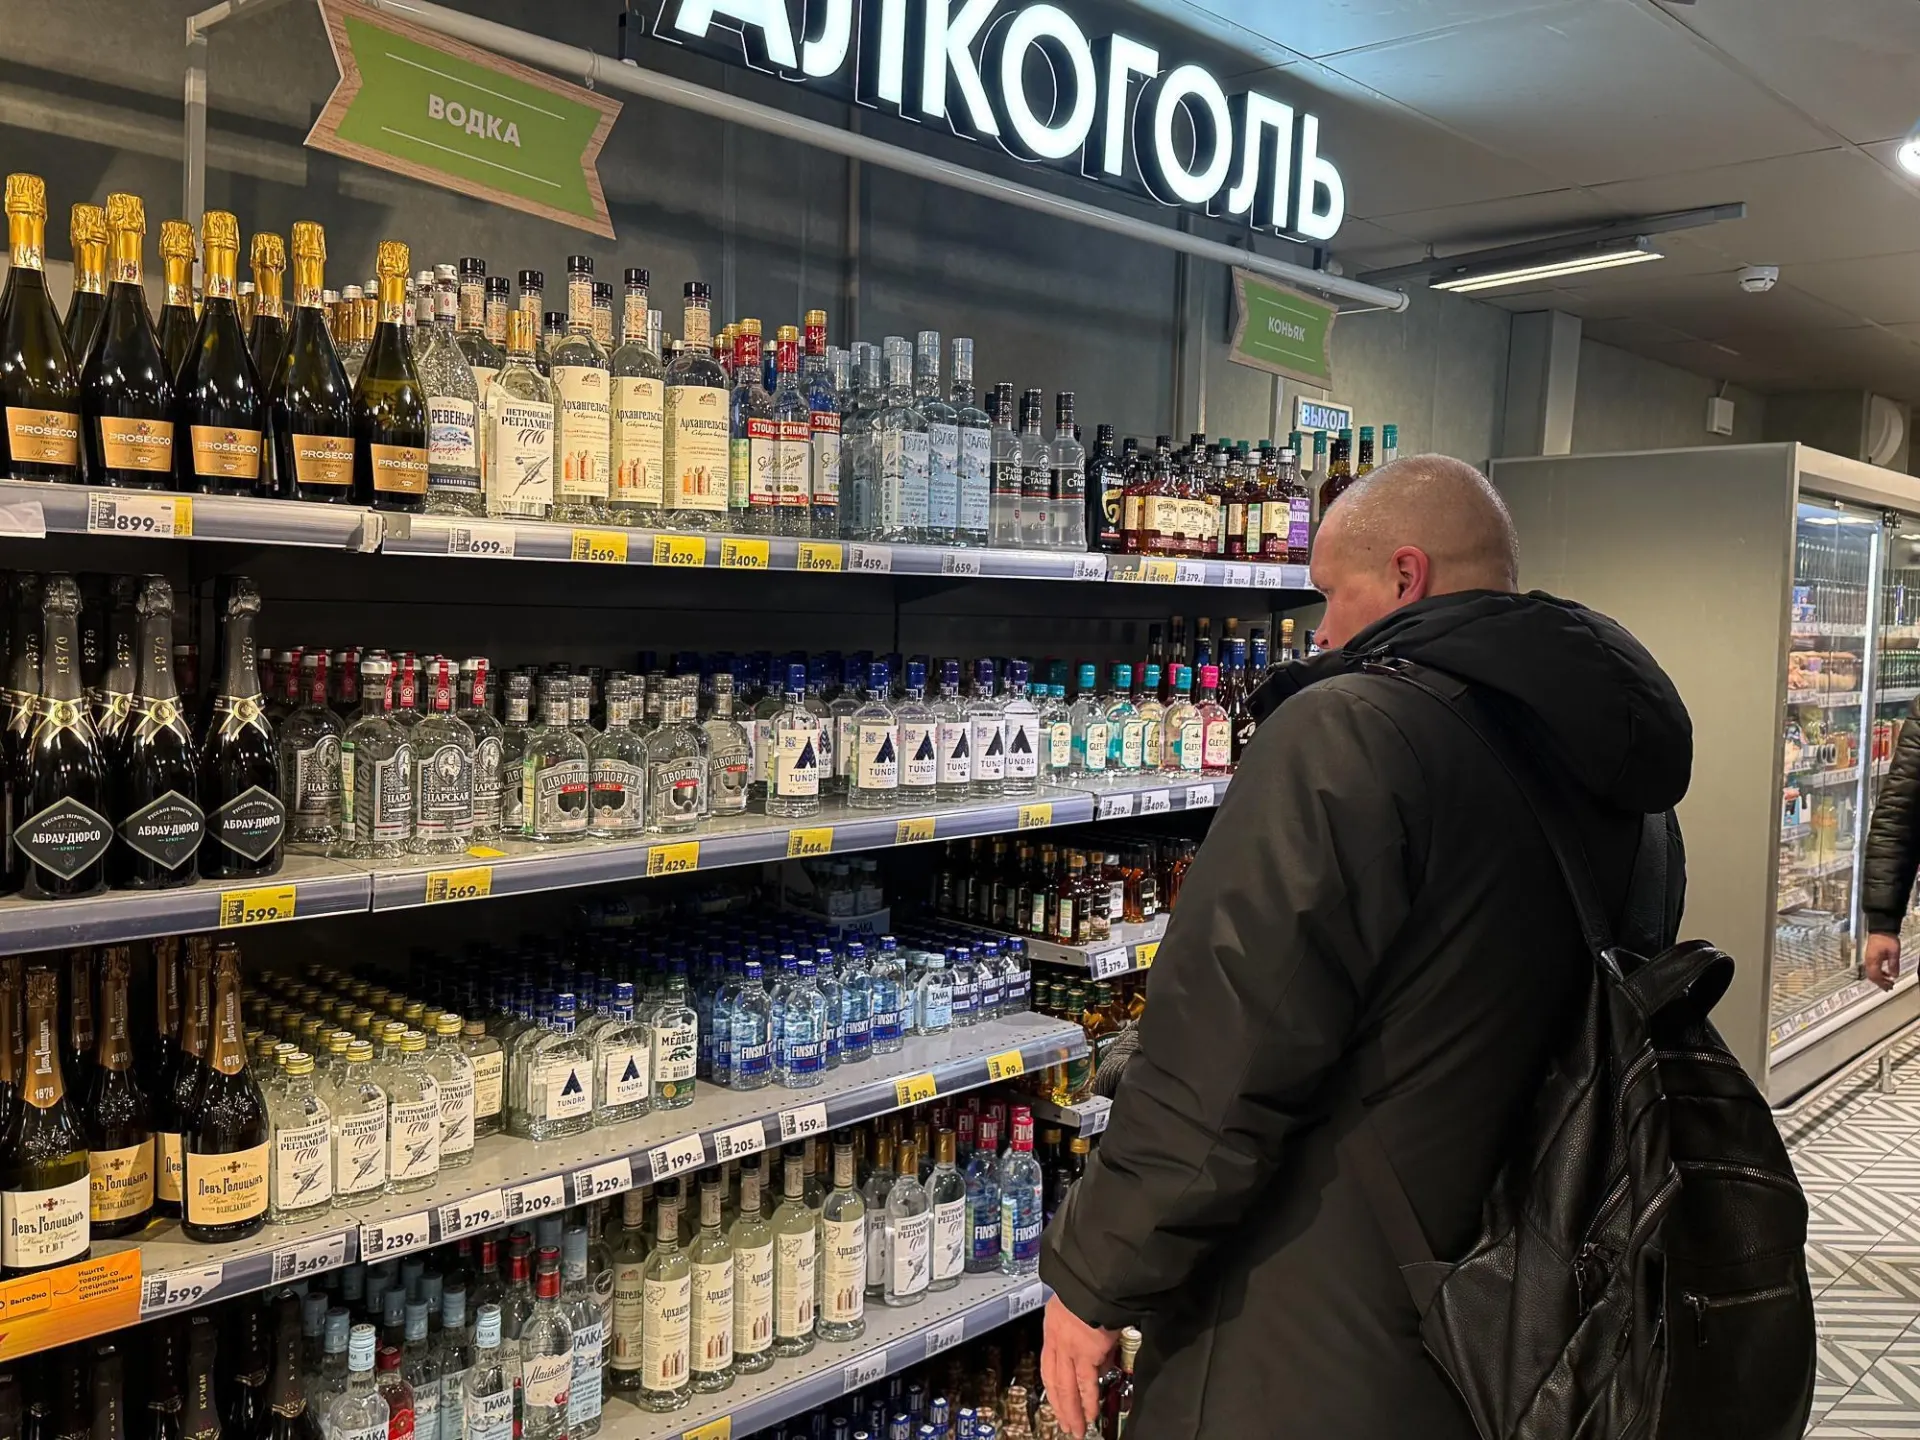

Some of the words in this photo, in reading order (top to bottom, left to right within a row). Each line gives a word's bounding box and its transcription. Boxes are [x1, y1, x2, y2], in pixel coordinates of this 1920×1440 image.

[428, 94, 521, 148] ВОДКА
[1268, 316, 1305, 342] КОНЬЯК
[506, 408, 552, 420] ПЕТРОВСКИЙ
[1302, 404, 1346, 430] ВЫХОД
[15, 424, 78, 438] PROSECCO
[109, 433, 171, 445] PROSECCO
[517, 429, 545, 447] 1716
[198, 441, 258, 453] PROSECCO
[301, 450, 353, 460] PROSECCO
[378, 459, 428, 470] PROSECCO
[117, 515, 154, 531] 899
[470, 540, 500, 553] 699
[591, 549, 614, 561] 569
[671, 553, 694, 565] 629
[737, 556, 758, 567] 409
[812, 559, 832, 570] 699
[863, 560, 881, 570] 459
[955, 563, 971, 573] 659
[1085, 568, 1099, 577] 569
[55, 636, 69, 674] 1870
[154, 636, 168, 673] 1870
[242, 636, 253, 671] 1870
[1004, 757, 1035, 765] TUNDRA
[427, 792, 469, 802] ЦАРСКАЯ
[1194, 795, 1208, 805] 409
[1113, 806, 1126, 815] 219
[1151, 800, 1164, 810] 409
[1030, 816, 1044, 827] 409
[909, 832, 925, 843] 444
[802, 843, 821, 854] 444
[665, 860, 686, 872] 429
[448, 885, 476, 899] 569
[246, 907, 277, 922] 599
[1109, 961, 1121, 972] 379
[874, 1012, 898, 1025] FINSKY
[845, 1020, 869, 1034] FINSKY
[742, 1043, 767, 1059] FINSKY
[792, 1042, 818, 1058] FINSKY
[1005, 1065, 1016, 1075] 99
[617, 1082, 643, 1093] TUNDRA
[557, 1096, 586, 1107] TUNDRA
[913, 1090, 928, 1101] 129
[799, 1119, 816, 1132] 159
[734, 1140, 753, 1154] 205
[671, 1153, 692, 1169] 199
[105, 1171, 149, 1192] Голицынъ
[198, 1176, 222, 1196] Левъ
[223, 1174, 264, 1195] Голицынъ
[596, 1177, 619, 1193] 229
[525, 1195, 551, 1212] 209
[11, 1217, 37, 1236] Левъ
[38, 1211, 84, 1235] Голицынъ
[464, 1210, 490, 1228] 279
[39, 1241, 64, 1254] БРЮТ
[386, 1232, 414, 1250] 239
[297, 1255, 328, 1273] 349
[78, 1266, 105, 1277] Ищите
[79, 1274, 108, 1285] товары
[79, 1286, 119, 1301] ценником
[168, 1286, 203, 1304] 599
[1020, 1297, 1034, 1309] 499
[859, 1368, 877, 1383] 469
[483, 1395, 511, 1413] ТАЛКА
[957, 1418, 975, 1437] ICE
